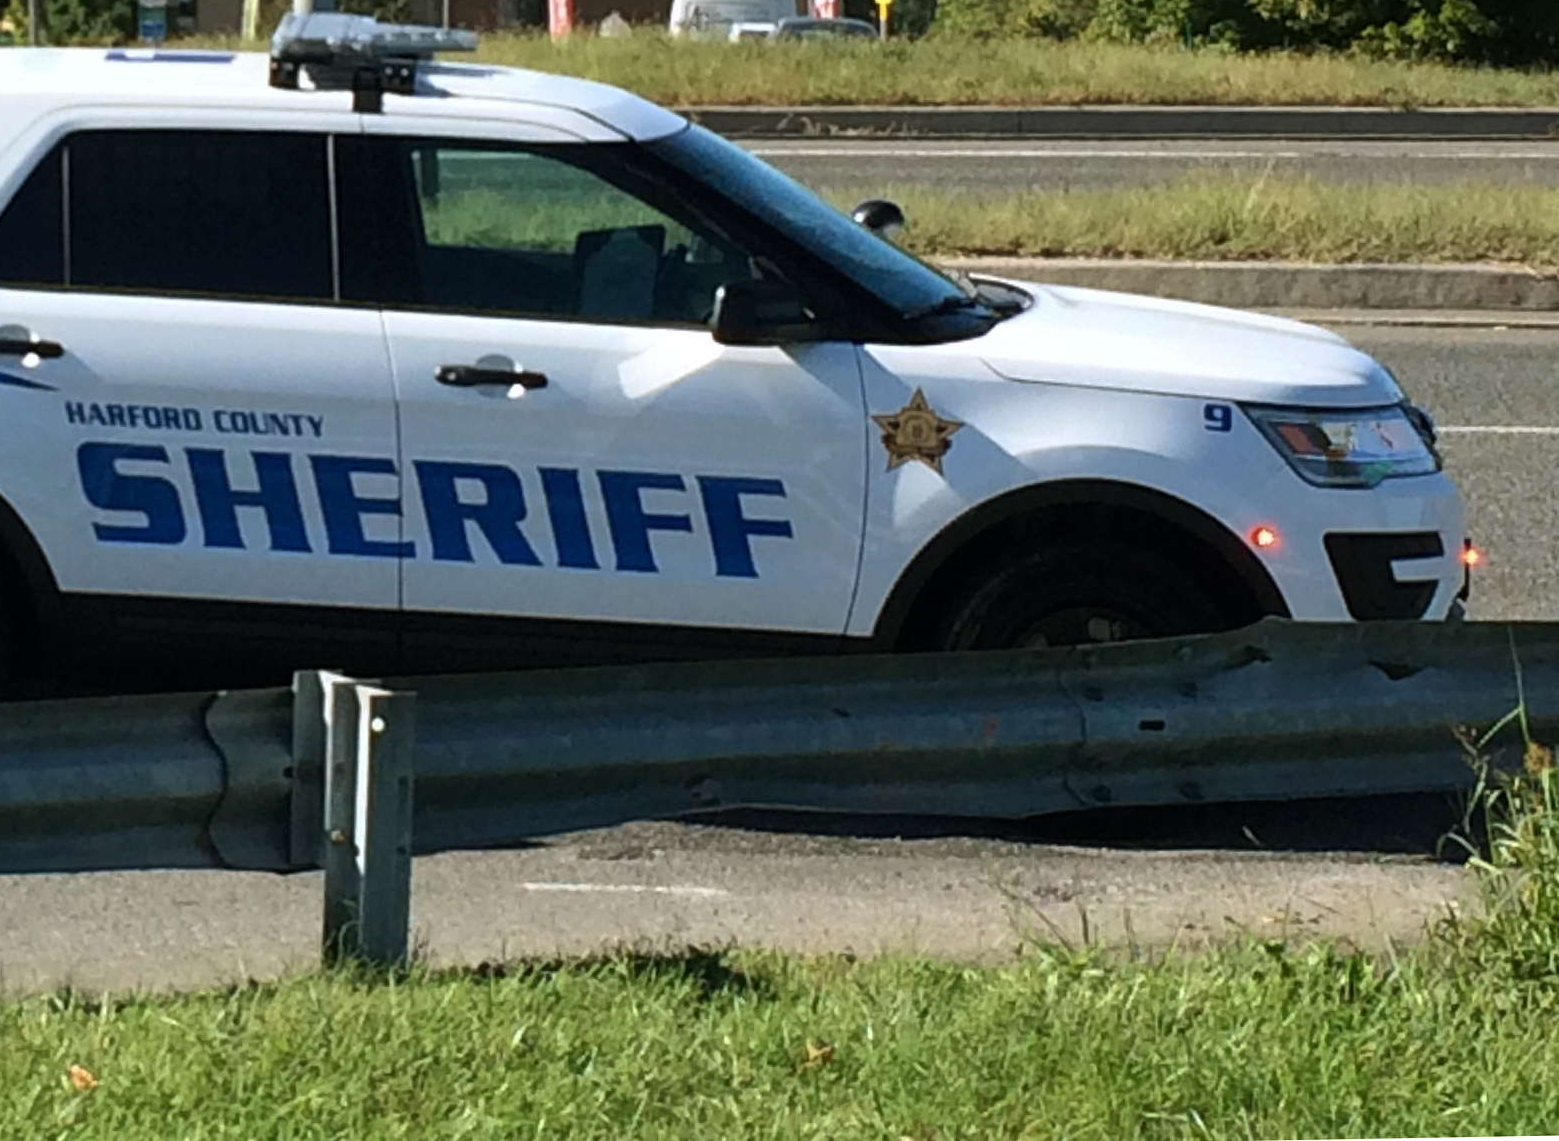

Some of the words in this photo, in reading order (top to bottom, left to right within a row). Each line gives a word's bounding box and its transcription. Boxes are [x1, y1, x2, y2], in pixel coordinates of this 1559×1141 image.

[65, 401, 203, 431] HARFORD
[212, 410, 324, 438] COUNTY
[1203, 403, 1233, 433] 9
[75, 441, 795, 579] SHERIFF
